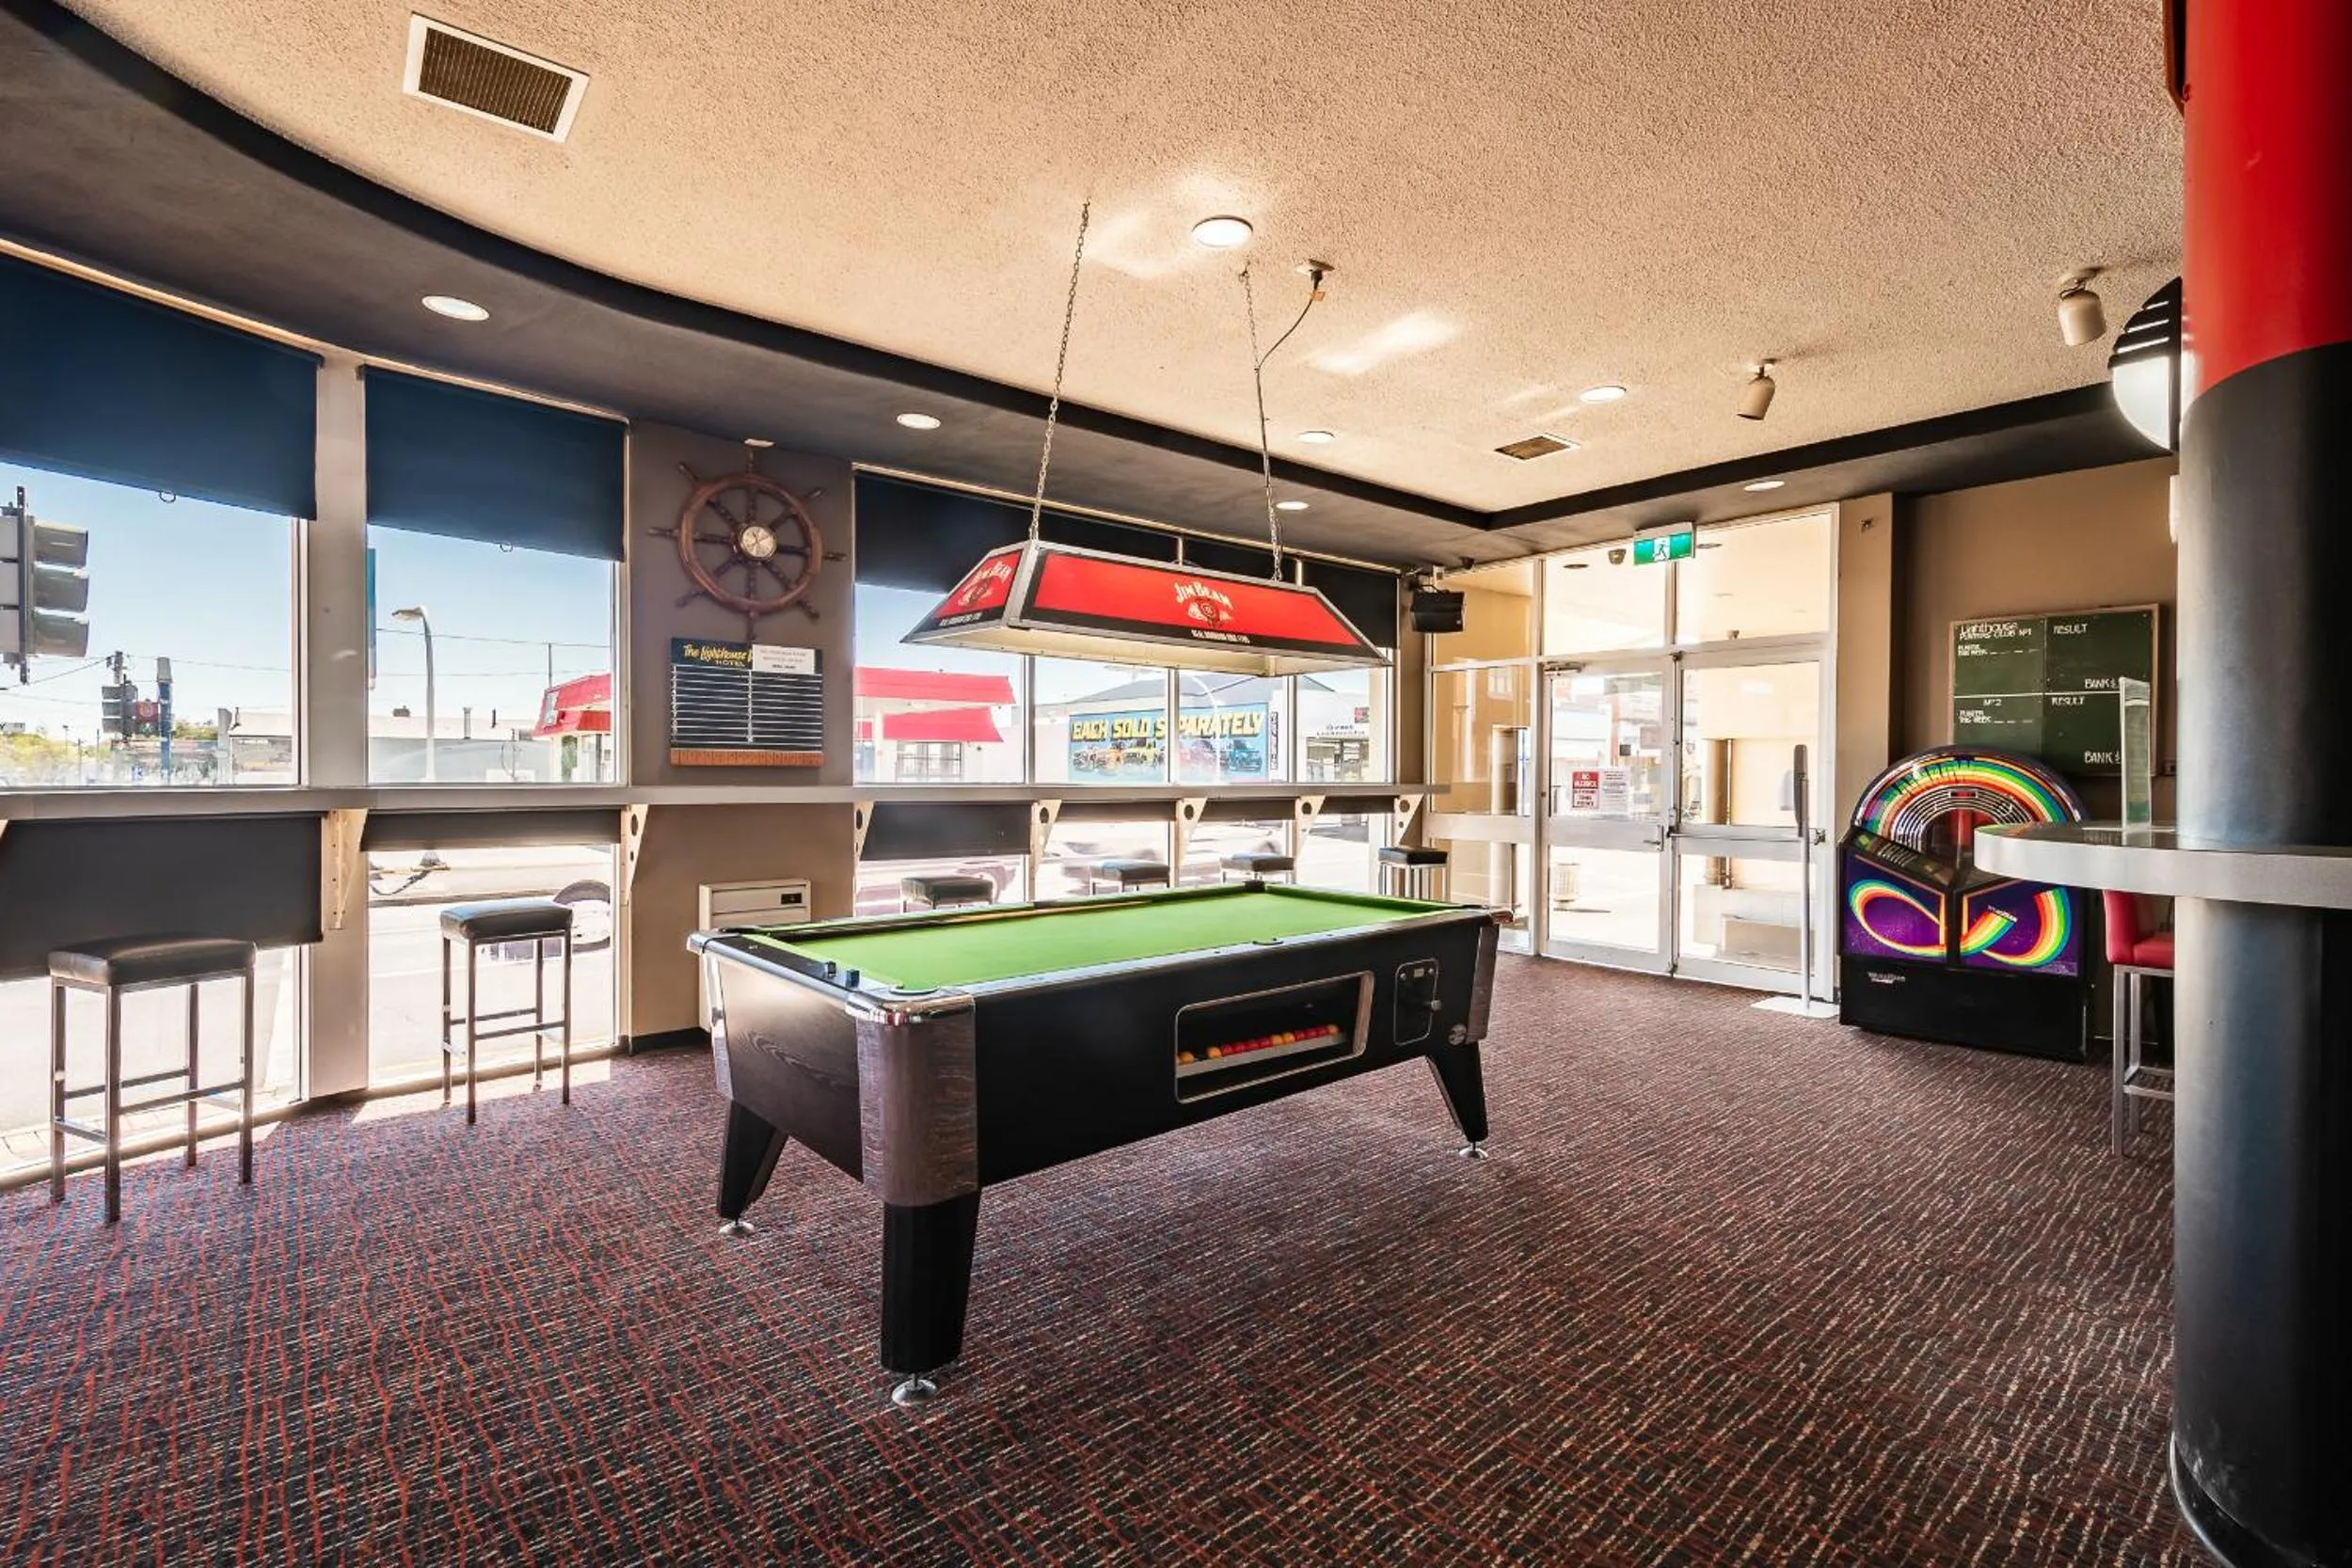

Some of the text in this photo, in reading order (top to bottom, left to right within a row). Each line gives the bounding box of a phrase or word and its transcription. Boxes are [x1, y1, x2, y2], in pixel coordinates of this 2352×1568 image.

[1193, 580, 1234, 610] BEAM
[2054, 624, 2088, 634] RESULT
[683, 644, 700, 657] The
[2085, 678, 2109, 689] BANK
[2052, 697, 2085, 705] RESULT
[1072, 712, 1263, 741] EACH SOLD SPARATELY
[2085, 751, 2113, 764] BANK
